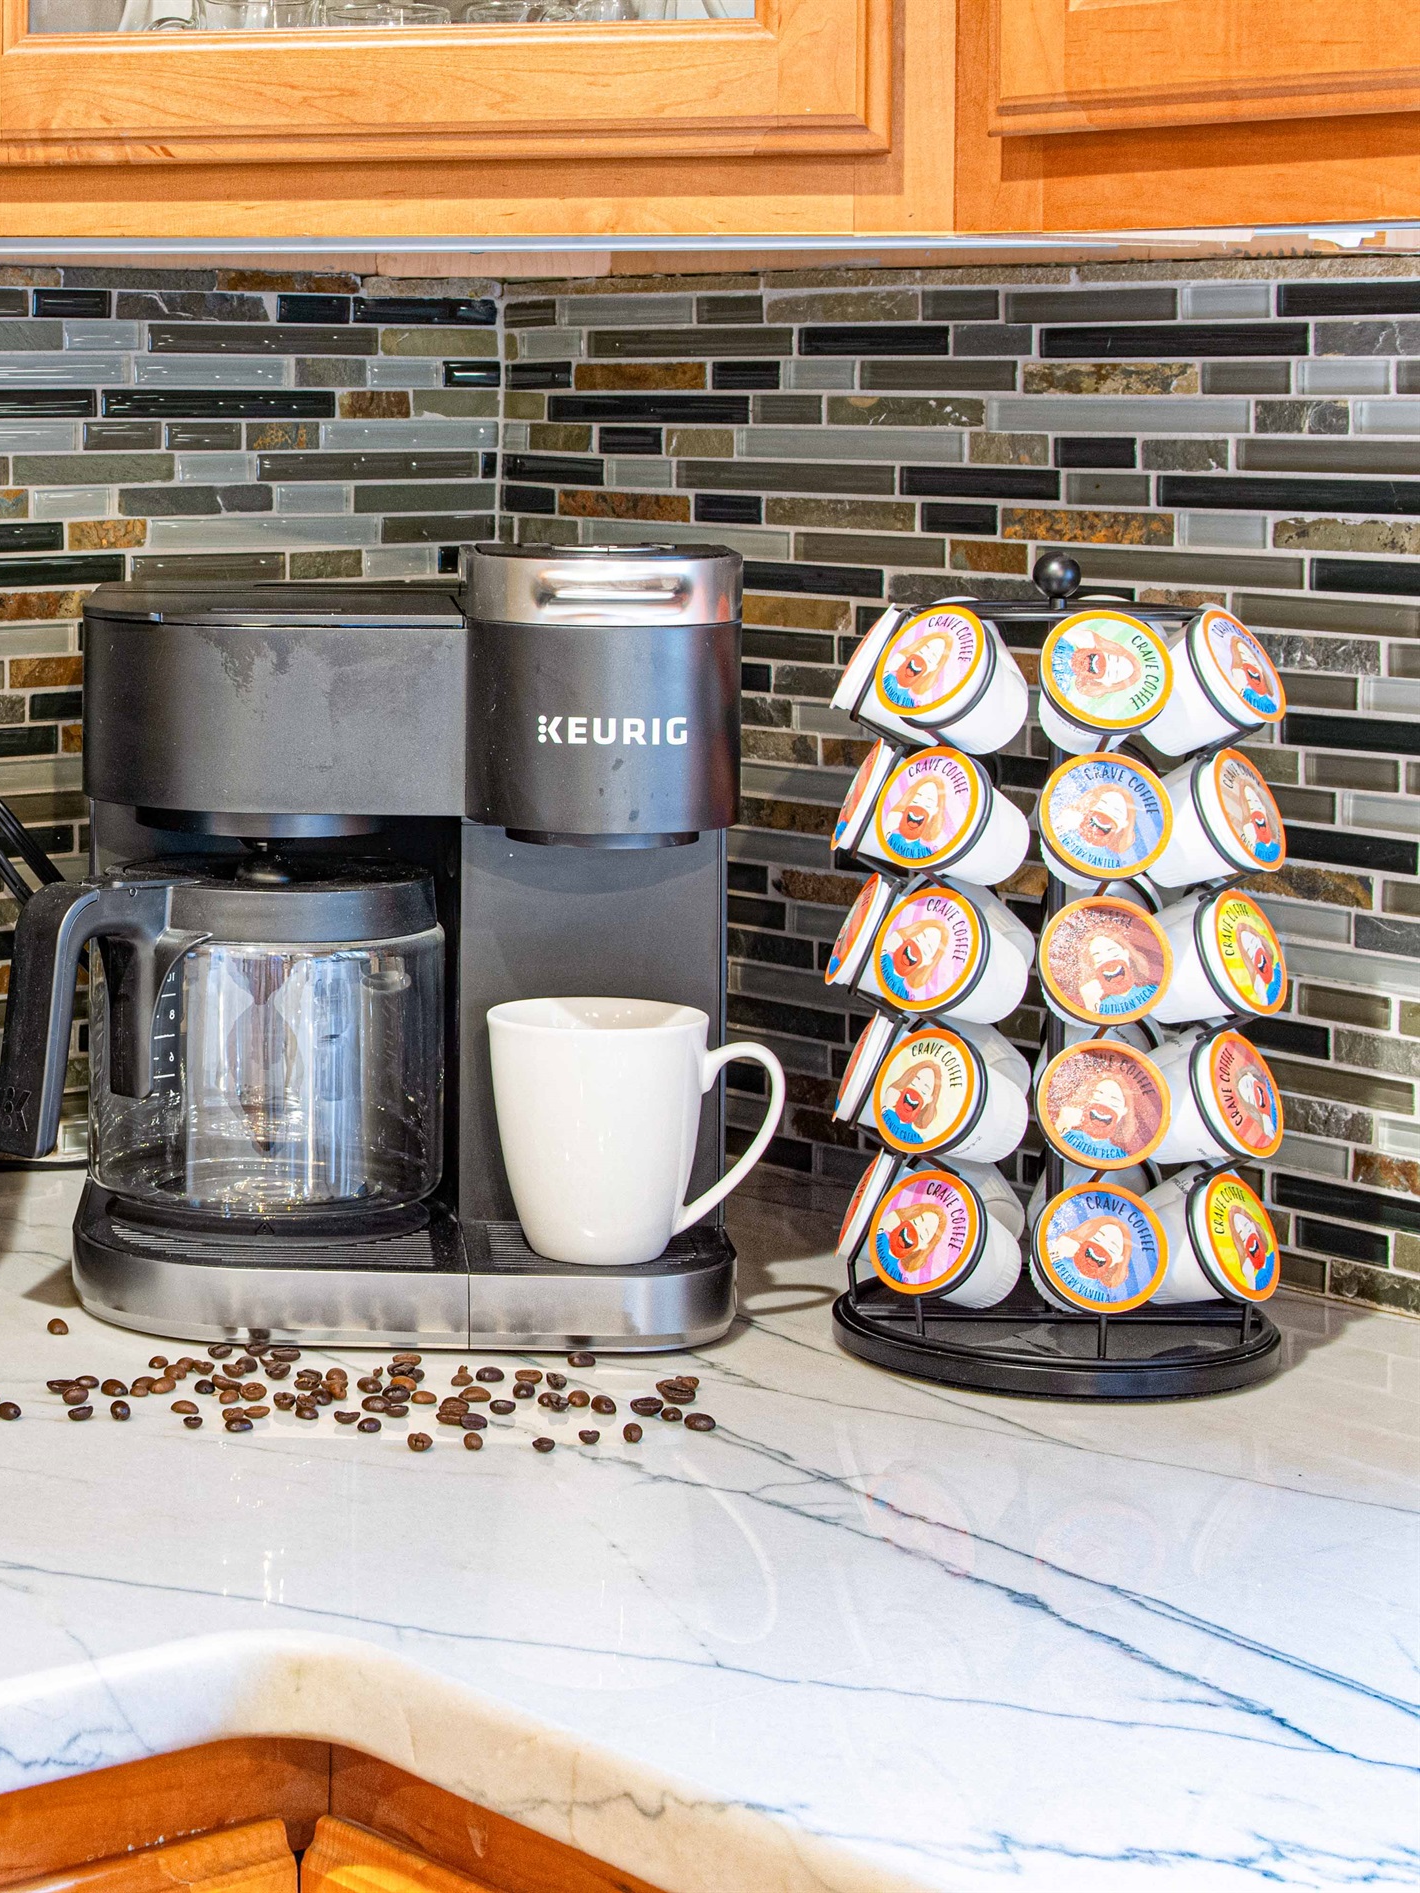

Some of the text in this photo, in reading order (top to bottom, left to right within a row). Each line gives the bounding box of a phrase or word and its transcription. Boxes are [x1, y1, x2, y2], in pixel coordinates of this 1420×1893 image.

[928, 615, 974, 662] CRAVE COFFEE
[1129, 635, 1159, 711] CRAVE COFFEE
[537, 715, 688, 746] KEURIG
[908, 758, 969, 795] CRAVE COFFEE
[1083, 765, 1160, 814] CRAVE COFFEE
[1088, 853, 1121, 869] VANILLA
[926, 898, 969, 963] CRAVE COFFEE
[1222, 918, 1235, 956] CRAVE
[1094, 984, 1158, 1014] SOUTHERN PECAN
[911, 1042, 963, 1088] CRAVE COFFEE
[1120, 1059, 1156, 1097] COFFEE
[1221, 1087, 1243, 1127] CRAVE
[1060, 1127, 1127, 1159] SOUTHERN PECAN
[926, 1182, 965, 1252] CRAVE COFFEE
[1085, 1196, 1156, 1253] CRAVE COFFEE
[1213, 1197, 1228, 1235] CRAVE
